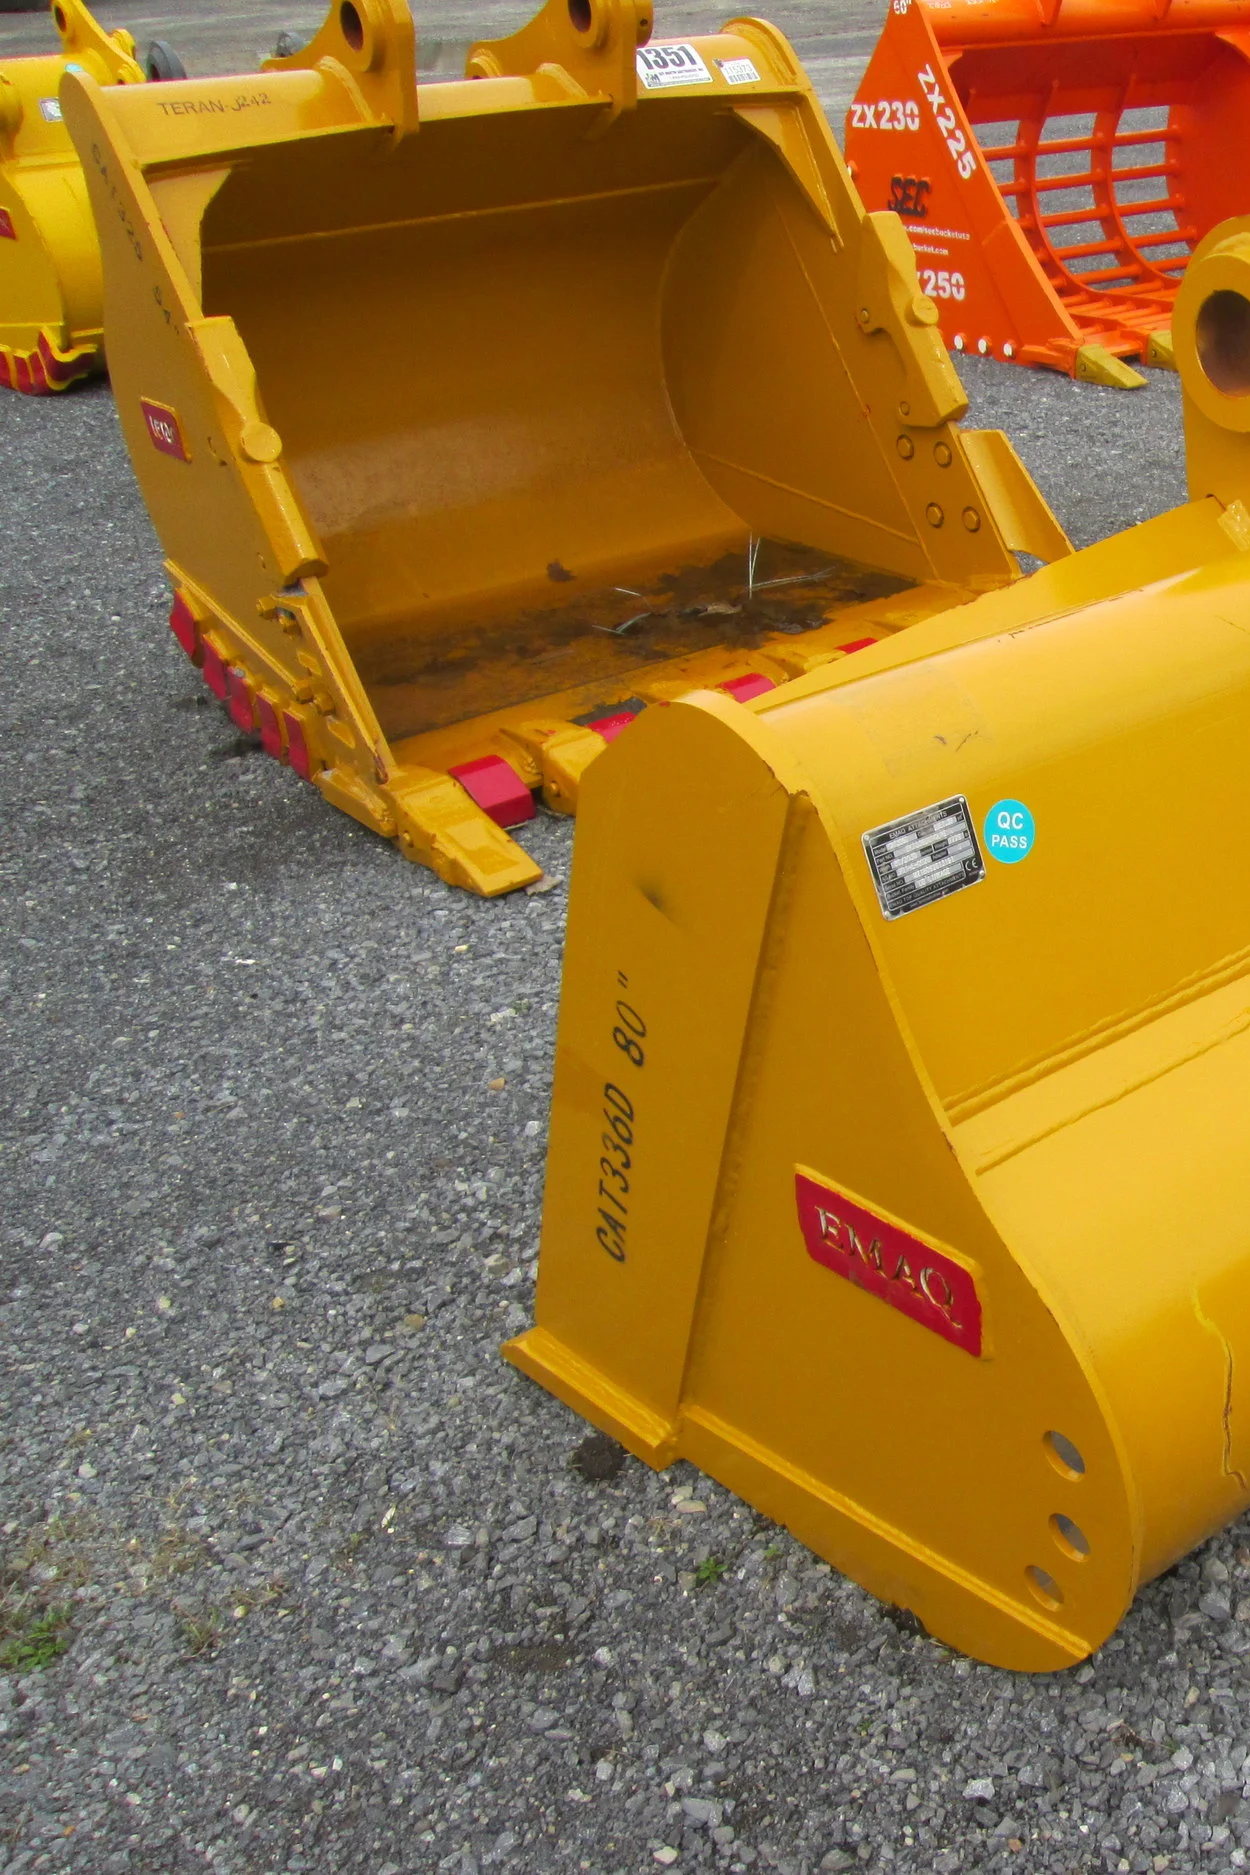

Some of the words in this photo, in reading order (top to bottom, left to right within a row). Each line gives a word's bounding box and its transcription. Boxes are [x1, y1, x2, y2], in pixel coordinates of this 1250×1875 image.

[636, 46, 697, 70] 1351
[851, 100, 920, 131] ZX230
[918, 63, 977, 180] ZX225
[916, 269, 966, 301] 250
[997, 811, 1025, 830] QC
[991, 834, 1028, 849] PASS
[596, 1081, 635, 1264] CAT336D
[814, 1205, 963, 1329] EMAQ
